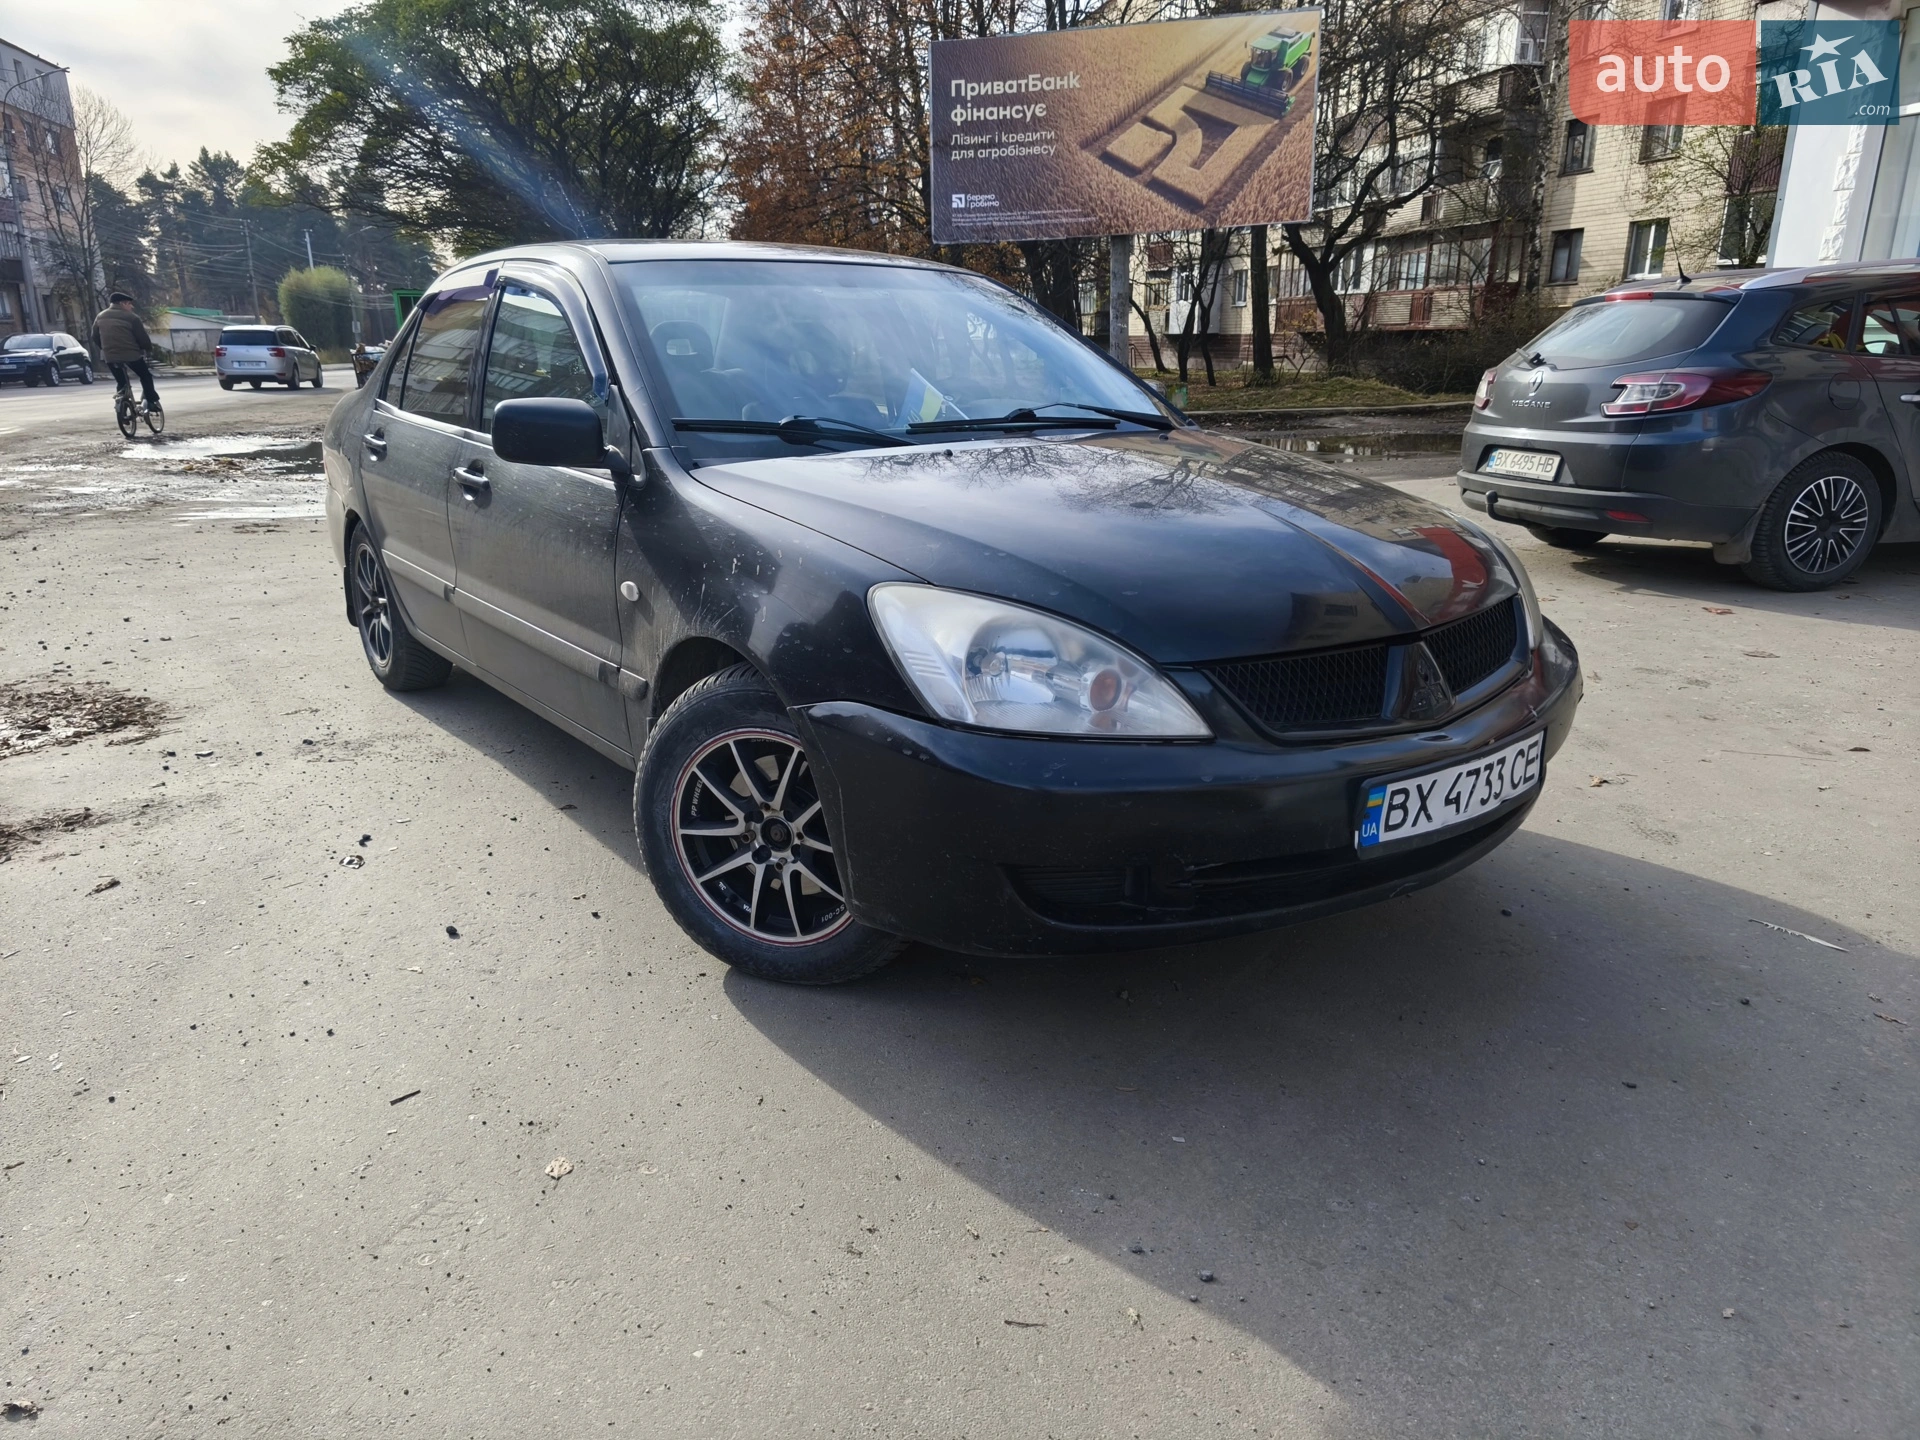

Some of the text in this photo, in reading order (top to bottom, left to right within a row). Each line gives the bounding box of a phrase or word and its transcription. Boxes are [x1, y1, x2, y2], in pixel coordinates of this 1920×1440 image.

[951, 71, 1081, 100] ПриватБанк
[951, 102, 1047, 126] фінансує
[951, 131, 1055, 146] Лізинг і кредити
[951, 144, 1056, 161] для агробізнесу
[966, 193, 996, 201] беремо
[970, 200, 1000, 209] робимо
[1511, 399, 1551, 409] MEGANE
[1494, 452, 1555, 473] BX 6495 HB
[1383, 739, 1540, 833] BX 4733 CE
[1362, 822, 1378, 838] UA
